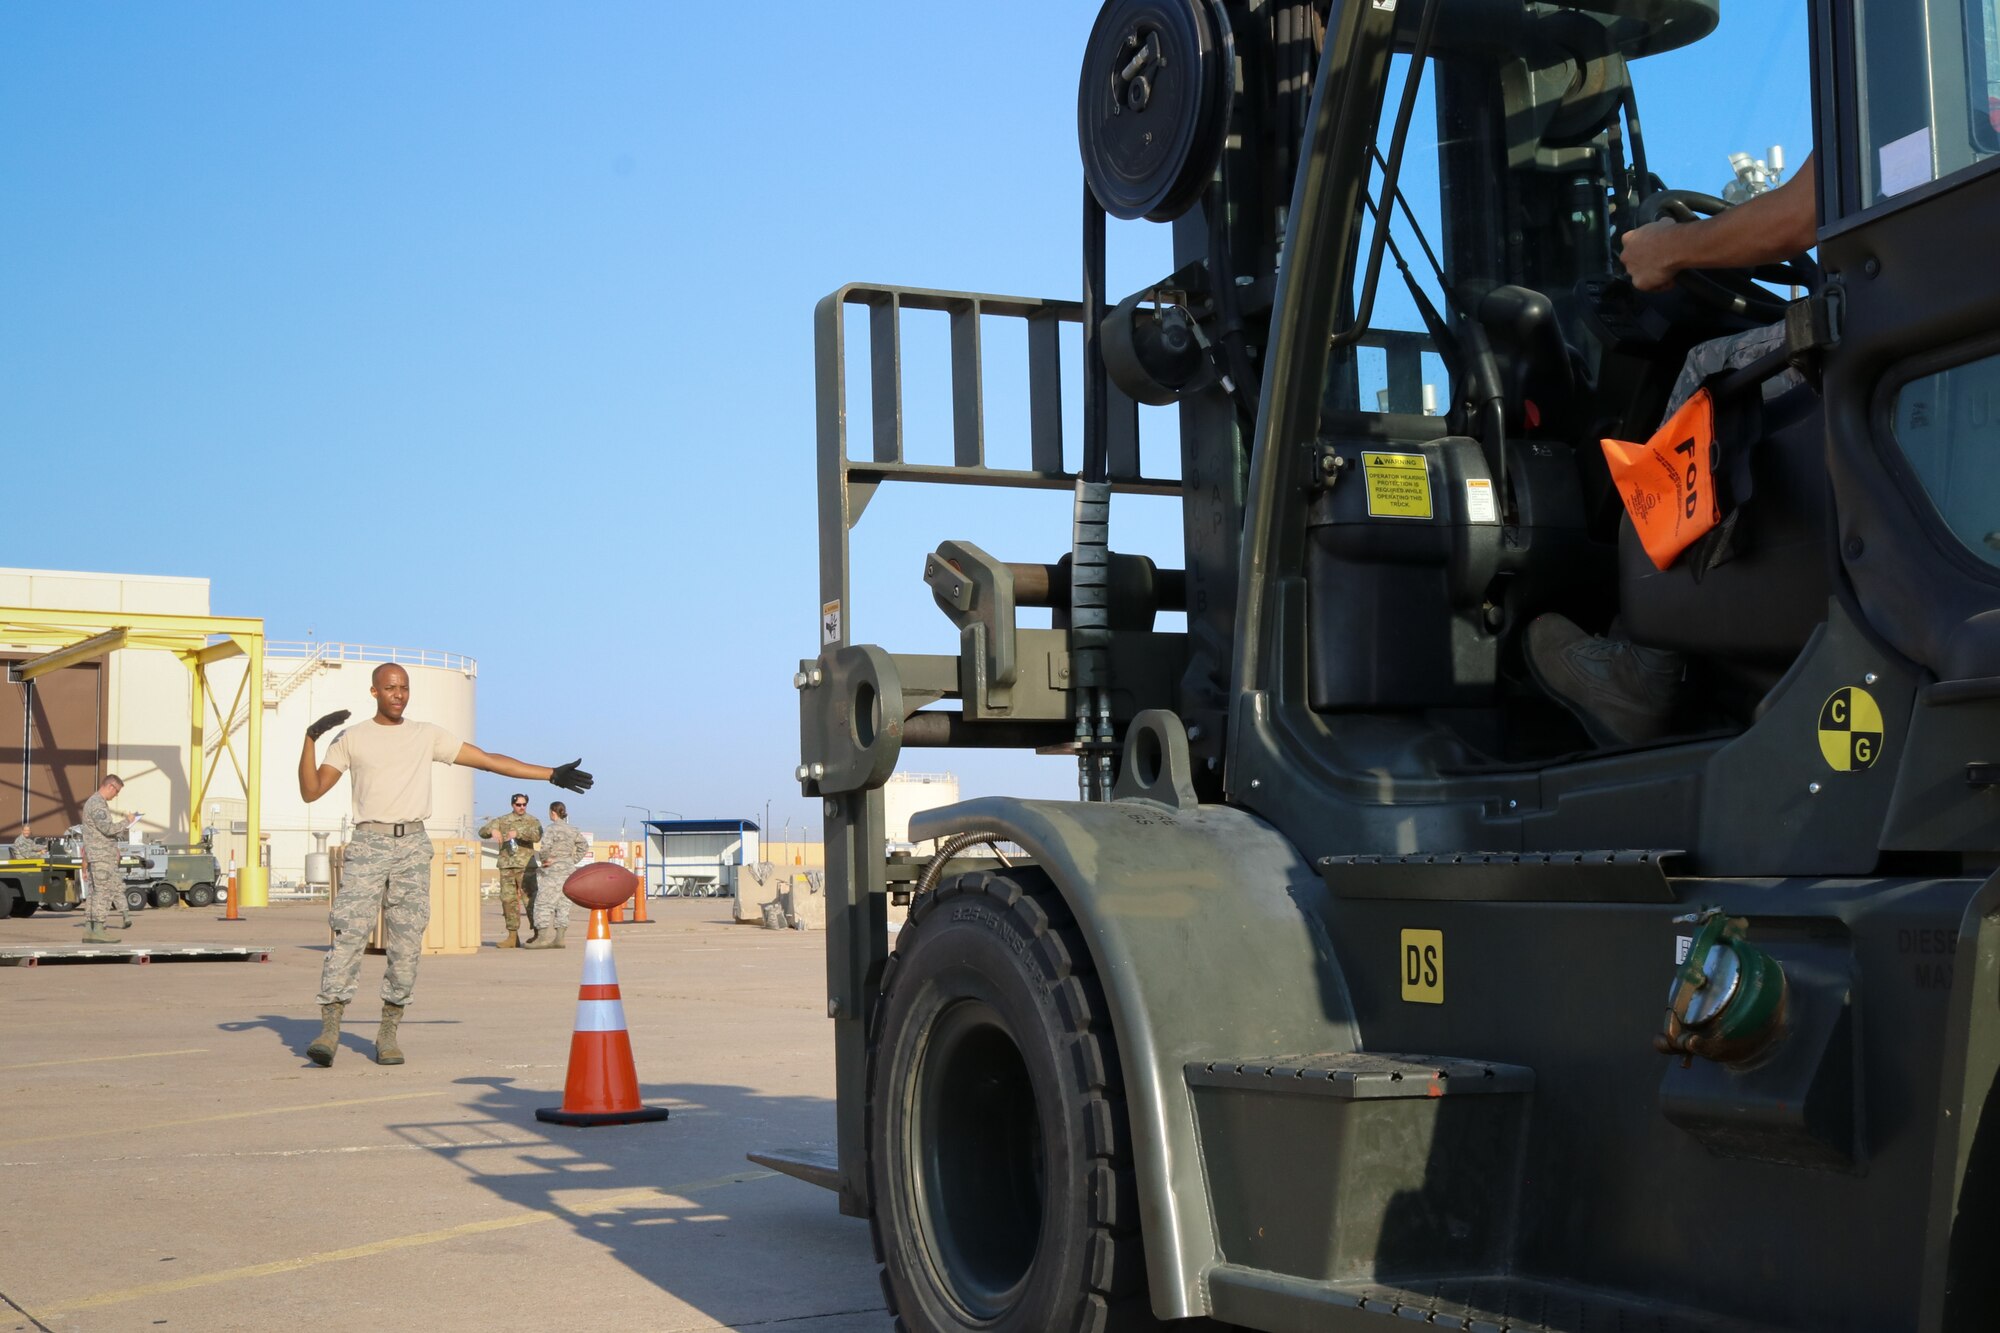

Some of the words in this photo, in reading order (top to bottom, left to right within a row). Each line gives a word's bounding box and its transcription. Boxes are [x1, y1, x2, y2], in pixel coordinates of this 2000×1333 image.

[1384, 458, 1416, 466] WARNING
[1674, 436, 1697, 519] FOD
[1831, 699, 1846, 723] C
[1855, 738, 1871, 762] G
[1406, 944, 1438, 988] DS
